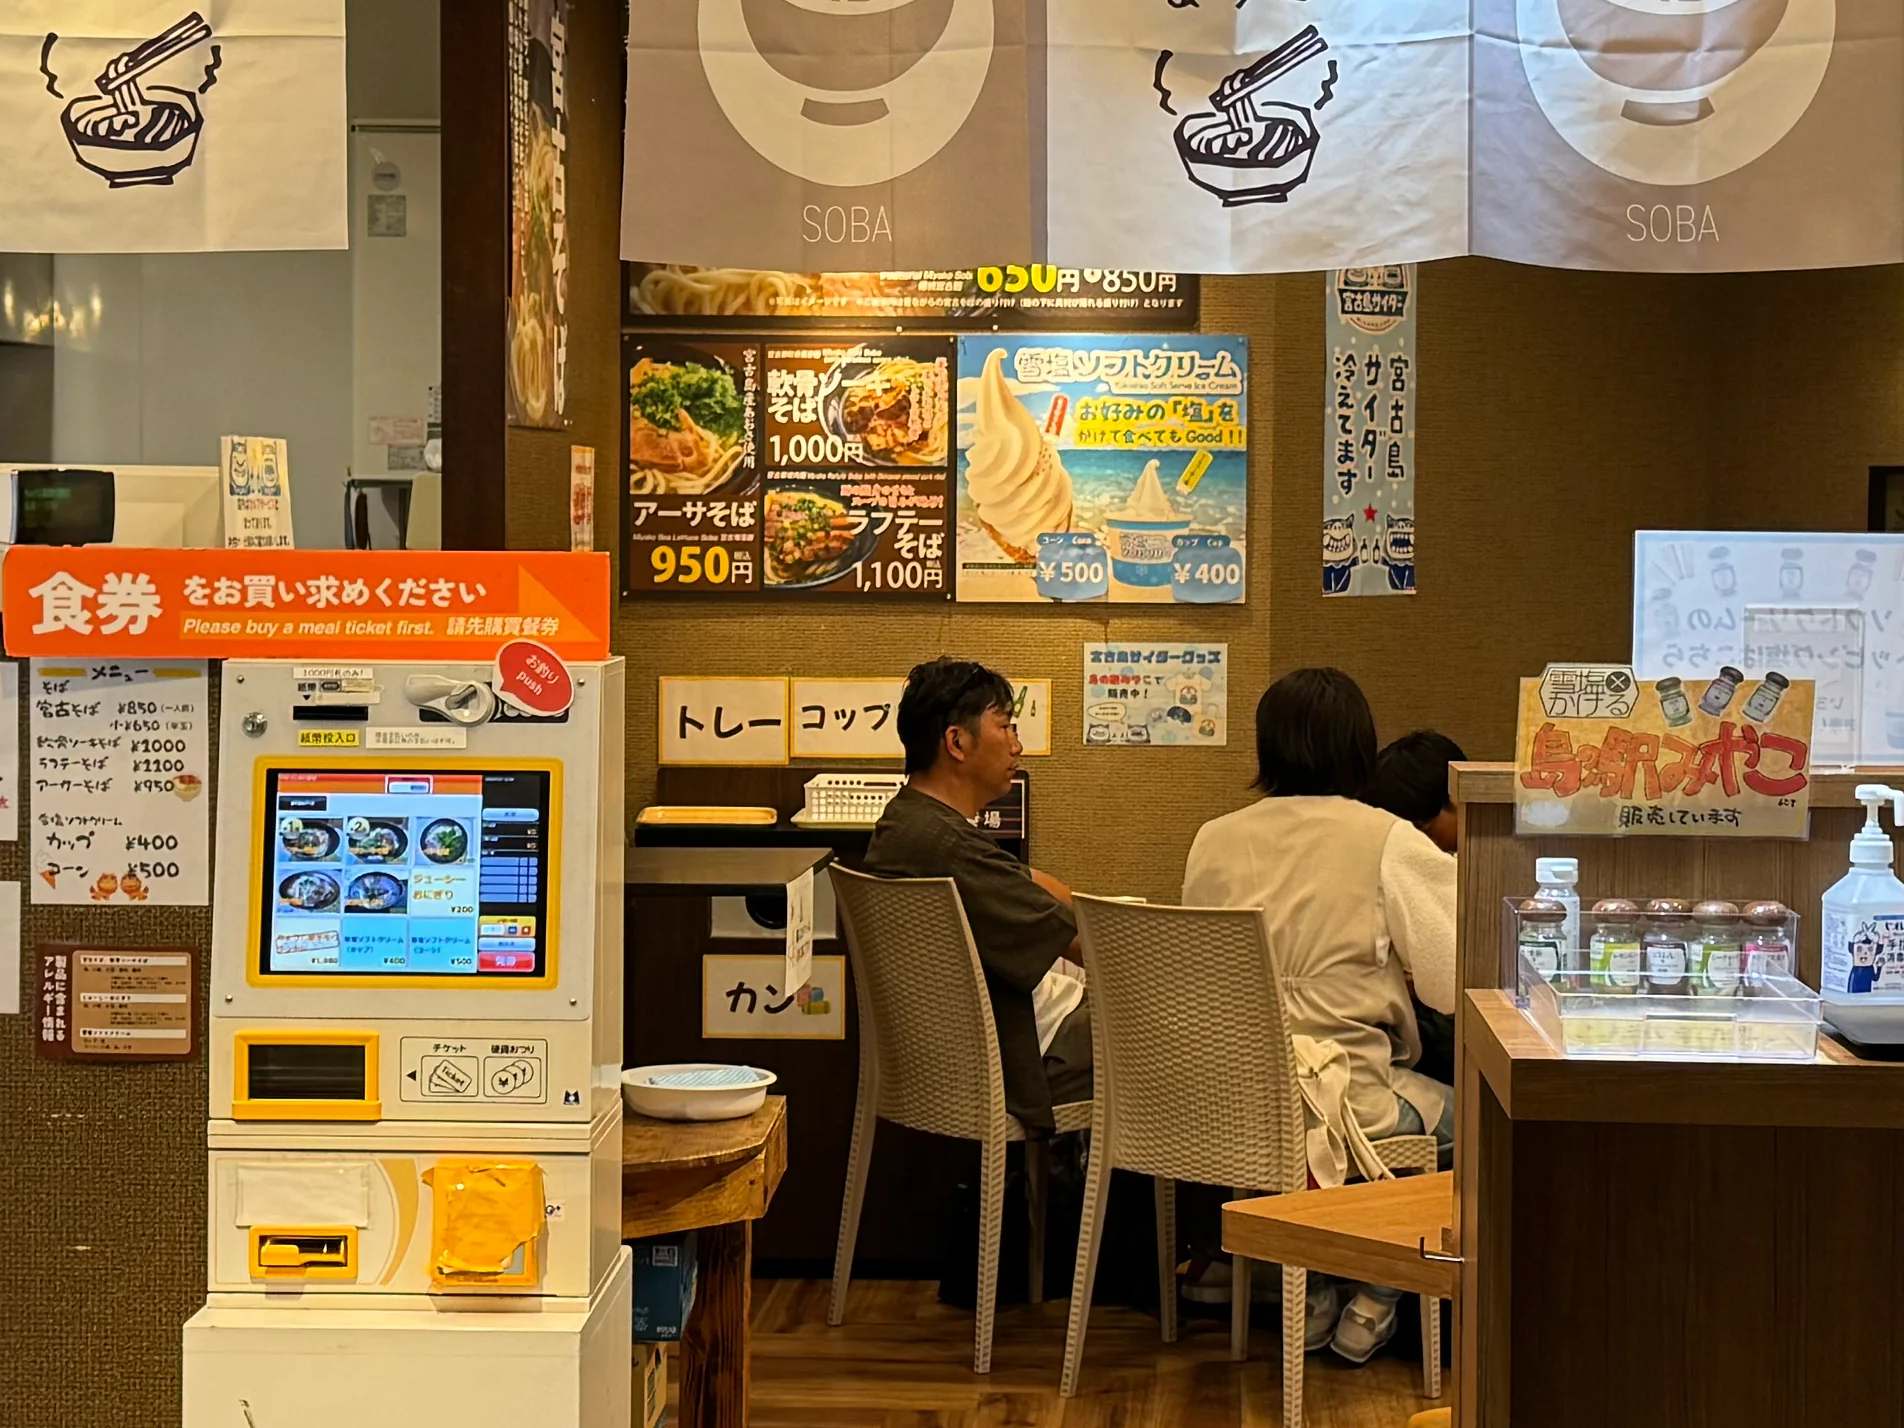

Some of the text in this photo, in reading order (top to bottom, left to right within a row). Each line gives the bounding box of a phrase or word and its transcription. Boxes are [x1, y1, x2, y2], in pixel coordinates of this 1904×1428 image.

[800, 203, 895, 246] SOBA
[1625, 203, 1721, 246] SOBA
[1342, 291, 1402, 313] 宮古島サイダー
[1017, 352, 1237, 380] 雪塩ソフトクリーム
[767, 369, 892, 397] 軟骨ソーキ
[767, 396, 818, 423] そば
[1079, 400, 1235, 423] お好みの「塩」を
[1361, 353, 1386, 481] サイダー
[1387, 354, 1410, 480] 宮古島
[1079, 429, 1223, 444] かけて食べても Good
[1334, 352, 1358, 496] 冷えてます
[769, 434, 864, 466] 1,000円
[633, 500, 758, 528] アーサそば
[846, 510, 944, 536] ラフテー
[894, 533, 945, 559] そば
[852, 561, 943, 592] 1,100円
[1039, 561, 1105, 583] ¥500
[1173, 562, 1239, 584] ¥400
[28, 570, 488, 636] 食券 をお買い求めください
[184, 618, 242, 637] Please
[245, 619, 280, 639] buy
[282, 623, 295, 636] a
[298, 618, 342, 637] meal
[344, 618, 394, 637] ticket
[396, 618, 436, 637] first.
[91, 664, 150, 682] メニュー
[525, 654, 561, 685] お釣り
[42, 680, 70, 695] そば
[515, 670, 545, 697] push
[36, 700, 101, 718] 宮古そば
[118, 701, 158, 715] ¥850
[800, 701, 891, 731] コップ
[1548, 692, 1632, 718] かける
[677, 704, 782, 740] トレー
[130, 738, 187, 754] ¥1000
[1520, 721, 1808, 801] 島の駅みやこ
[35, 776, 175, 794] アーサーそば ¥950
[1619, 806, 1743, 828] 販売しています
[46, 830, 179, 852] カップ ¥400
[126, 862, 181, 880] ¥500
[725, 980, 795, 1015] カン
[433, 1043, 467, 1054] チケット
